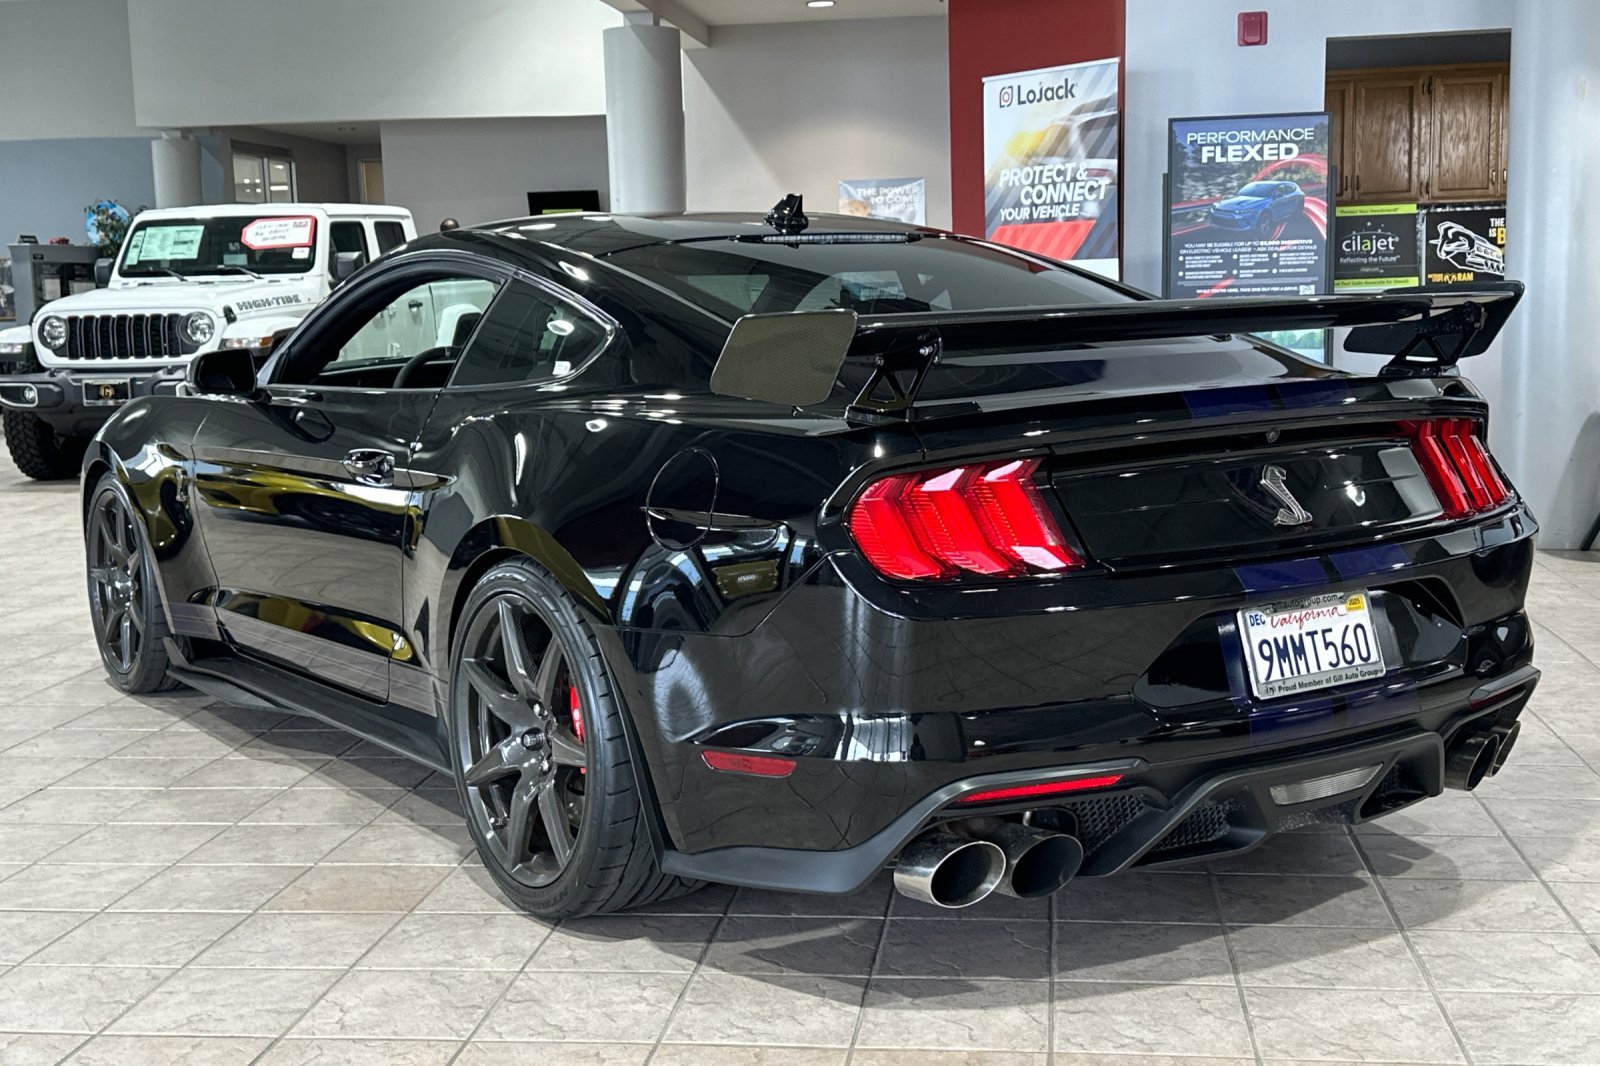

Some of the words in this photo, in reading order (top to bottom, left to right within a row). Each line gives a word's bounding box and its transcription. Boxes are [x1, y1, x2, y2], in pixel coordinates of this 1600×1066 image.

[1186, 127, 1315, 145] PERFORMANCE
[1201, 142, 1299, 163] FLEXED
[999, 162, 1076, 188] PROTECT
[1076, 162, 1088, 179] &
[856, 188, 877, 197] THE
[879, 185, 919, 196] POWER
[1020, 180, 1111, 205] CONNECT
[1000, 207, 1030, 222] YOUR
[1032, 203, 1080, 219] VEHICLE
[1490, 217, 1505, 227] THE
[1488, 227, 1497, 238] IS
[1340, 256, 1368, 264] Reflecting
[1457, 272, 1474, 282] RAM
[1249, 613, 1266, 627] DEC
[1270, 606, 1346, 629] California
[1257, 622, 1372, 682] 9MMT560
[1278, 683, 1297, 693] Proud
[1298, 678, 1324, 689] Member
[1333, 674, 1344, 683] Gill
[1345, 672, 1359, 681] Auto
[1360, 669, 1379, 680] Group
